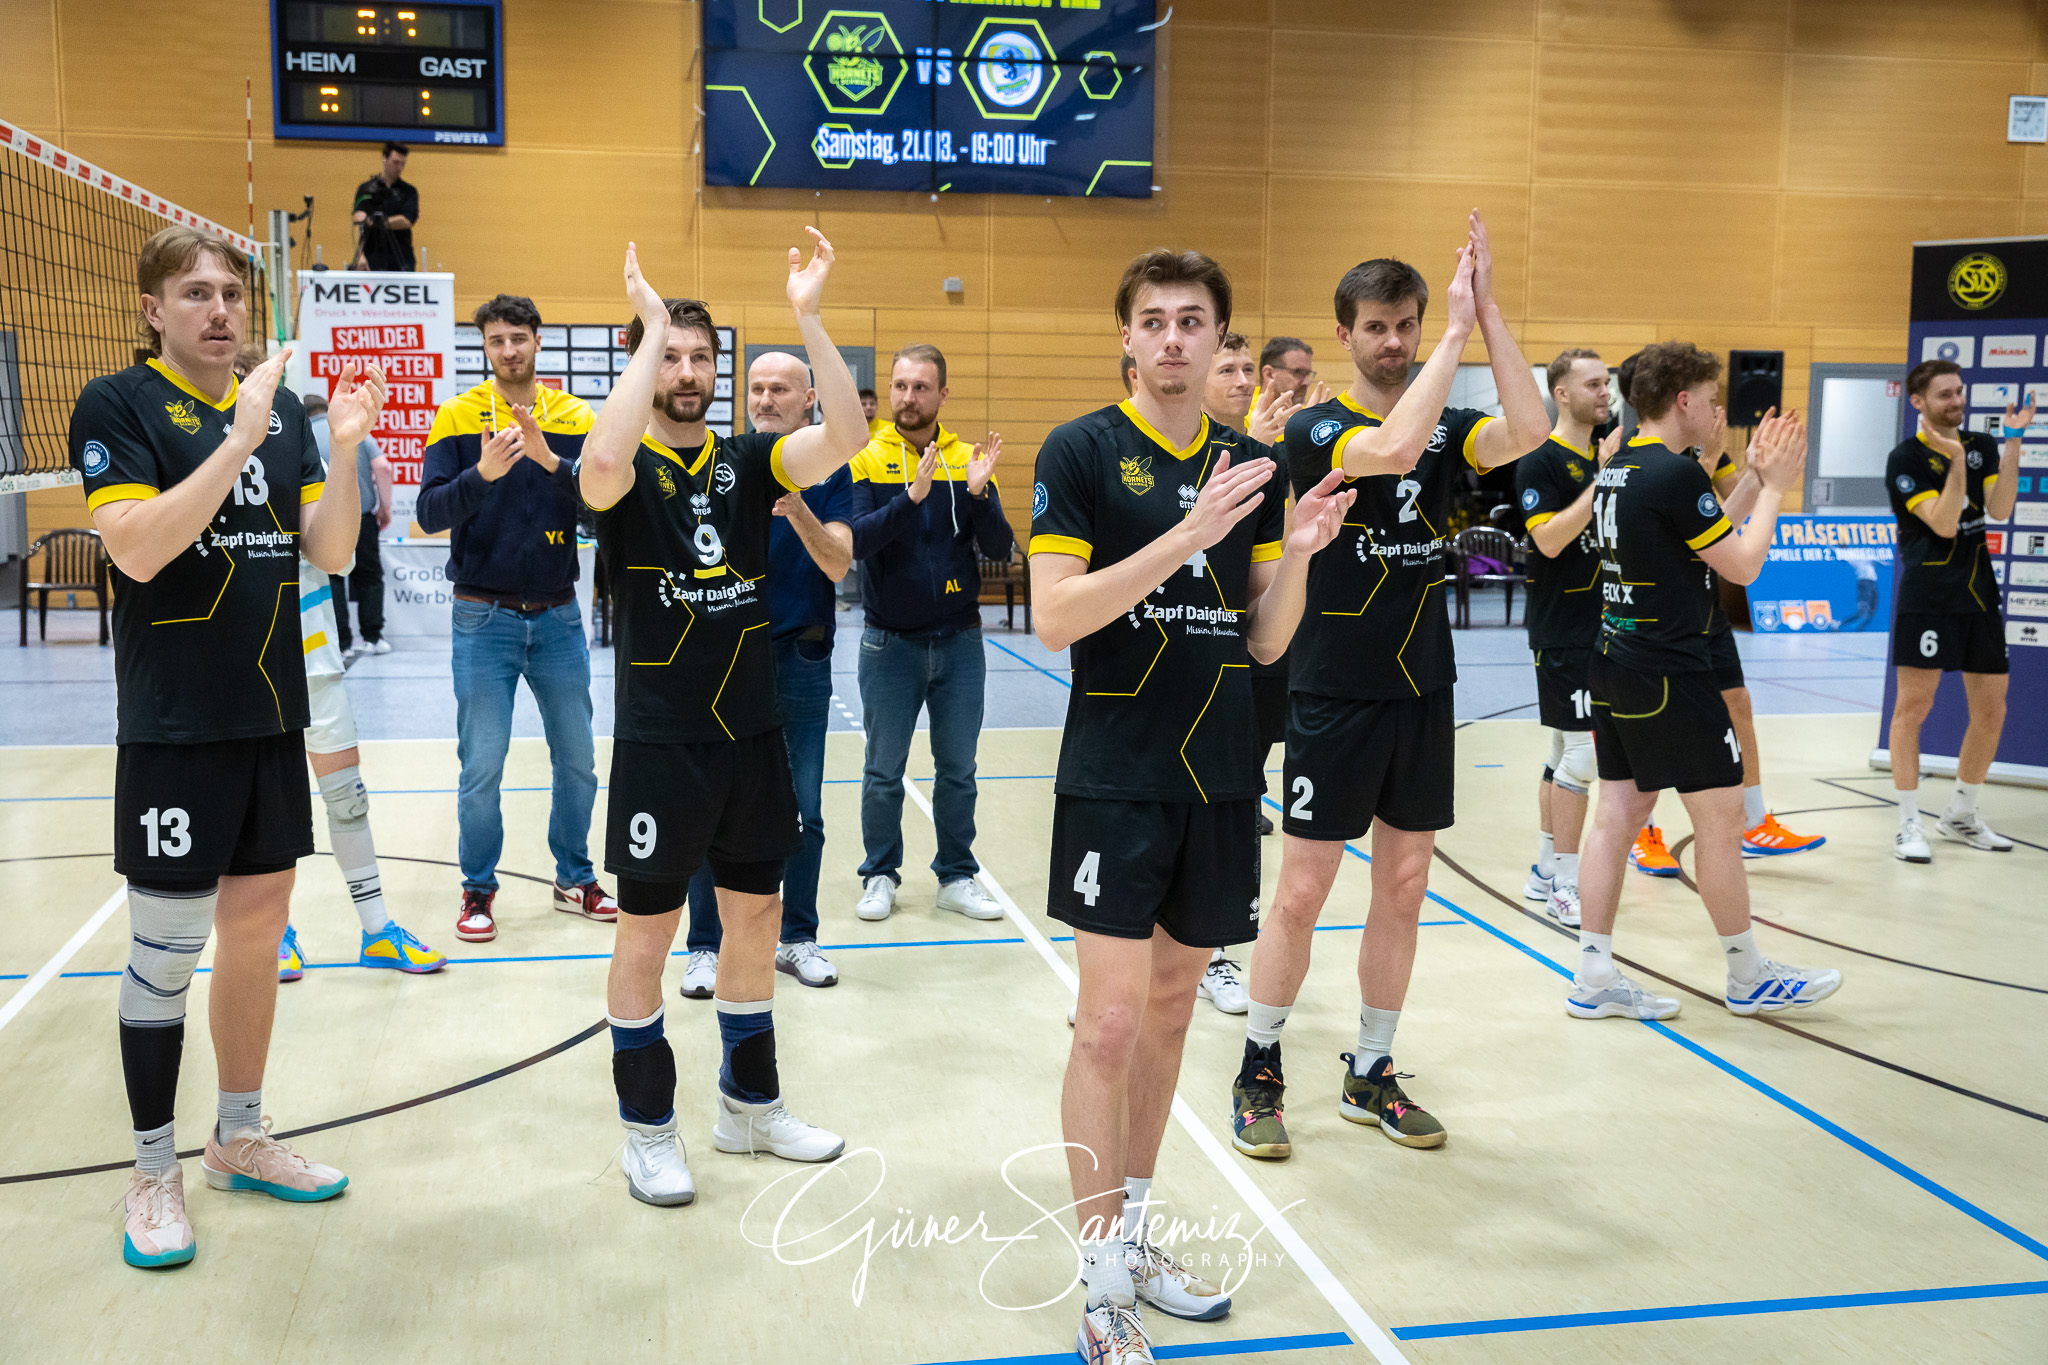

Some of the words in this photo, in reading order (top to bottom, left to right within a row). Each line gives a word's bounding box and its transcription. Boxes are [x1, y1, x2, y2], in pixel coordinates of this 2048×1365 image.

[286, 51, 356, 73] HEIM
[419, 56, 487, 79] GAST
[434, 131, 488, 144] PEWETA
[817, 126, 899, 165] Samstag,
[971, 131, 1016, 164] 19:00
[1017, 133, 1049, 165] Uhr
[315, 283, 439, 305] MEYSEL
[314, 308, 347, 318] Druck
[361, 308, 438, 318] Werbetechnik
[336, 326, 419, 350] SCHILDER
[1179, 500, 1196, 509] erre
[1396, 479, 1421, 523] 2
[1593, 493, 1618, 549] 14
[210, 532, 244, 549] Zapf
[245, 531, 294, 547] Daigfuss
[545, 530, 565, 545] YK
[1780, 519, 1898, 546] PRÄSENTIERT
[694, 524, 722, 566] 9
[1369, 543, 1402, 558] Zapf
[393, 565, 445, 582] Groß
[671, 587, 704, 603] Zapf
[945, 579, 962, 594] AL
[1143, 604, 1184, 622] Zapf
[1186, 606, 1238, 625] Daigfuss
[1919, 629, 1938, 658] 6
[1290, 776, 1314, 821] 2
[140, 807, 192, 857] 13
[628, 812, 657, 859] 9
[1073, 850, 1100, 907] 4
